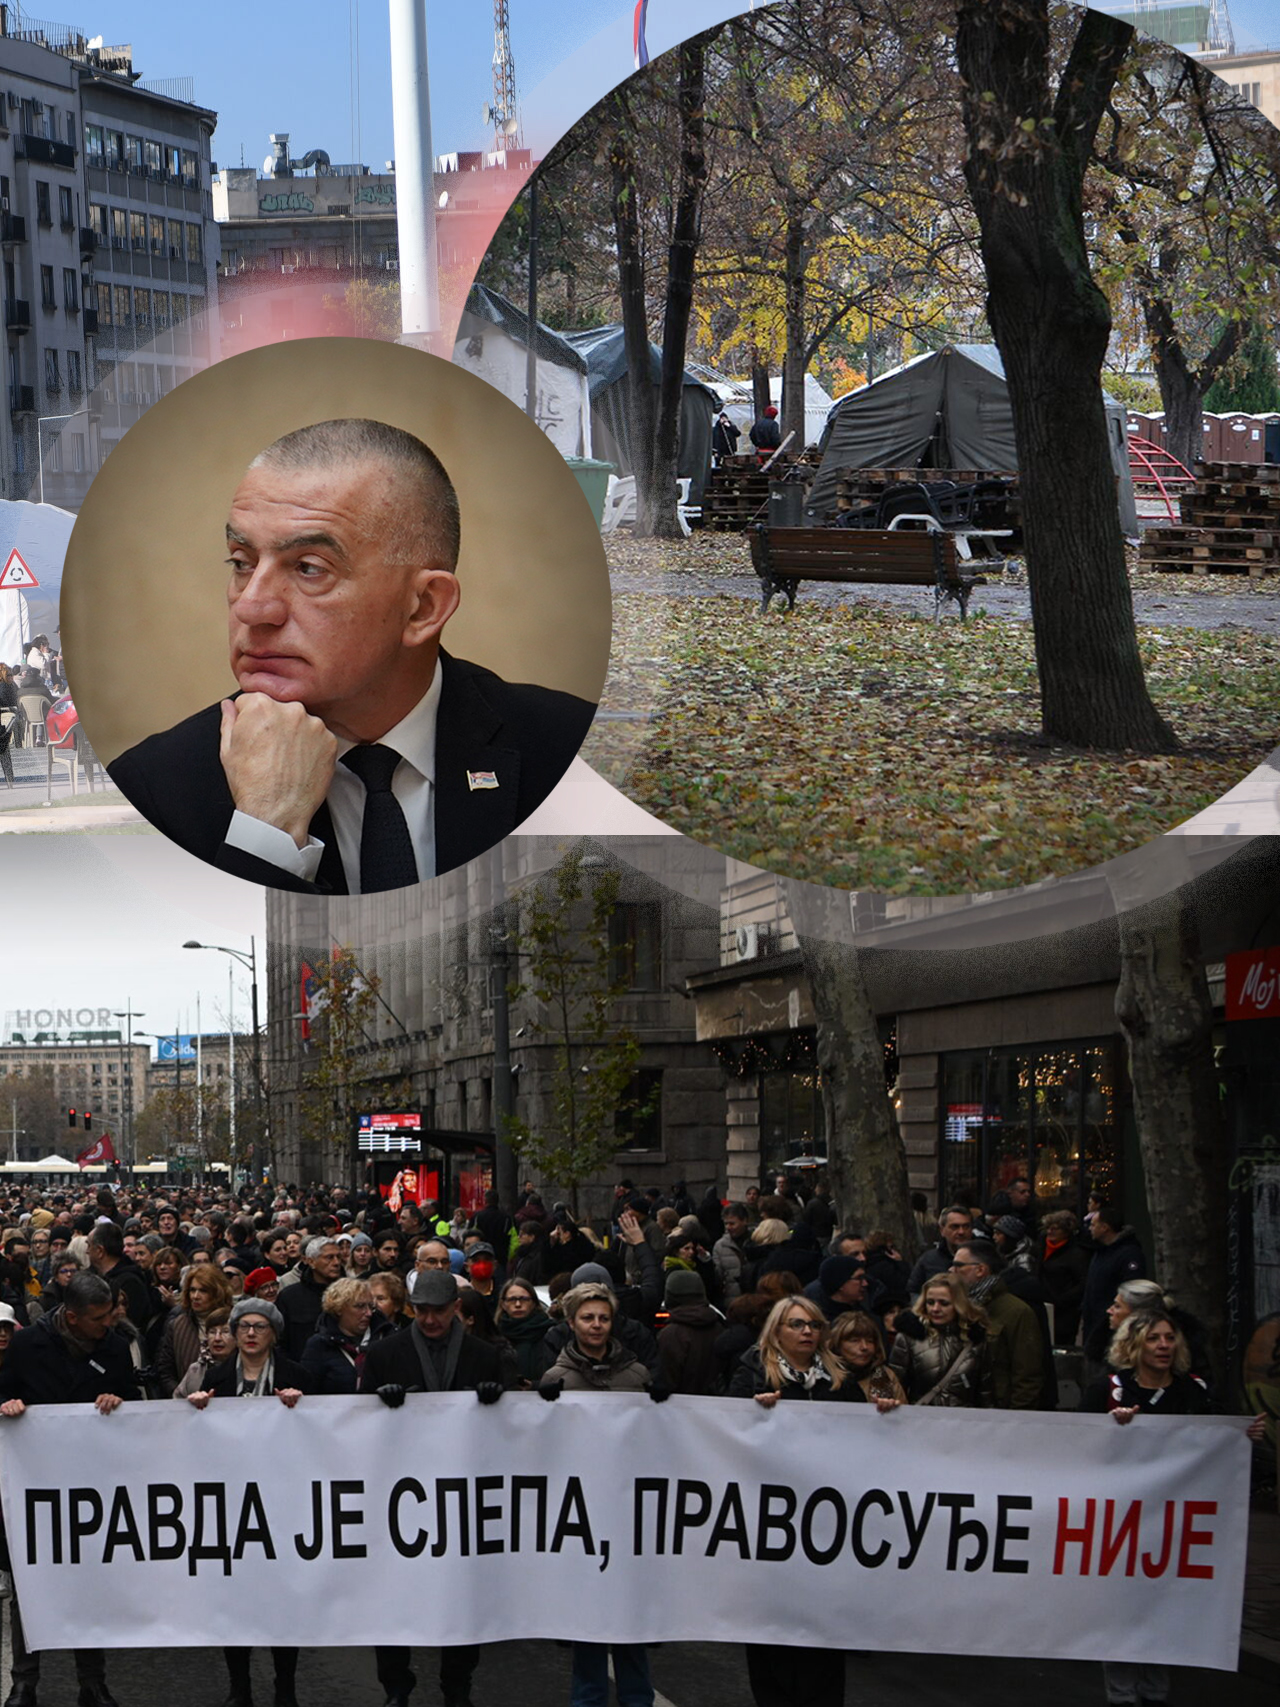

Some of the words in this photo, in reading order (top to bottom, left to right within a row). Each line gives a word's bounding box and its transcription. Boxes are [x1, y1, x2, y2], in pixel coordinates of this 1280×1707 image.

[1238, 961, 1277, 1010] Moj
[16, 1007, 112, 1029] HONOR
[25, 1482, 277, 1576] ПРАВДА
[294, 1480, 367, 1561] ЈЕ
[388, 1475, 610, 1572] СЛЕПА,
[633, 1477, 1032, 1573] ПРАВОСУЂЕ
[1052, 1497, 1217, 1579] НИЈЕ
